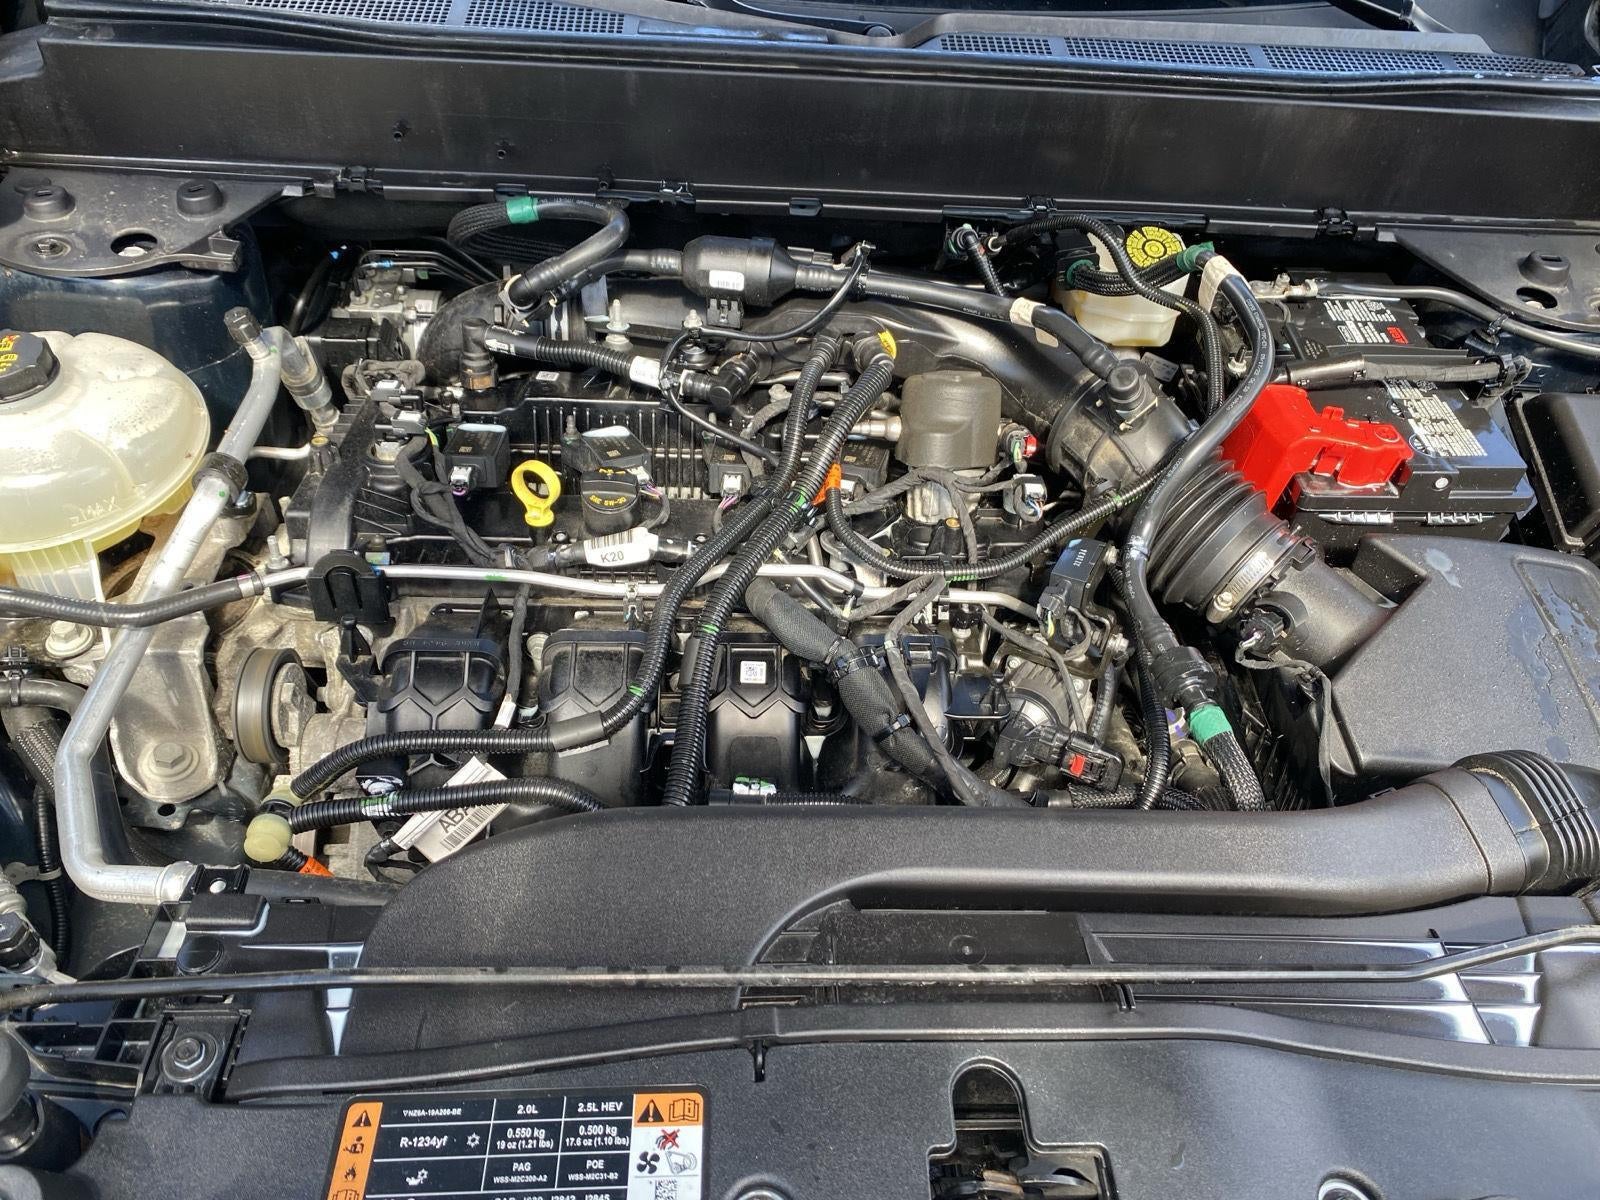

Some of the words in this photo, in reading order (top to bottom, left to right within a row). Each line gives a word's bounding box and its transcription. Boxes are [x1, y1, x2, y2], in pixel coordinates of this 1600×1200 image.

[601, 551, 624, 563] K20
[517, 1104, 538, 1114] 2.0L
[577, 1102, 598, 1112] 2.5L
[601, 1101, 623, 1112] HEV
[507, 1127, 532, 1139] 0.550
[533, 1127, 546, 1139] kg
[579, 1125, 604, 1136] 0.500
[605, 1124, 618, 1136] kg
[400, 1135, 448, 1149] R-1234yf
[497, 1141, 505, 1150] 19
[507, 1141, 517, 1149] oz
[518, 1139, 537, 1150] (1.21
[538, 1139, 554, 1149] lbs)
[583, 1138, 593, 1146] oz
[594, 1136, 613, 1147] (1.10
[614, 1135, 630, 1146] lbs)
[512, 1162, 532, 1172] PAG
[586, 1159, 605, 1170] POE
